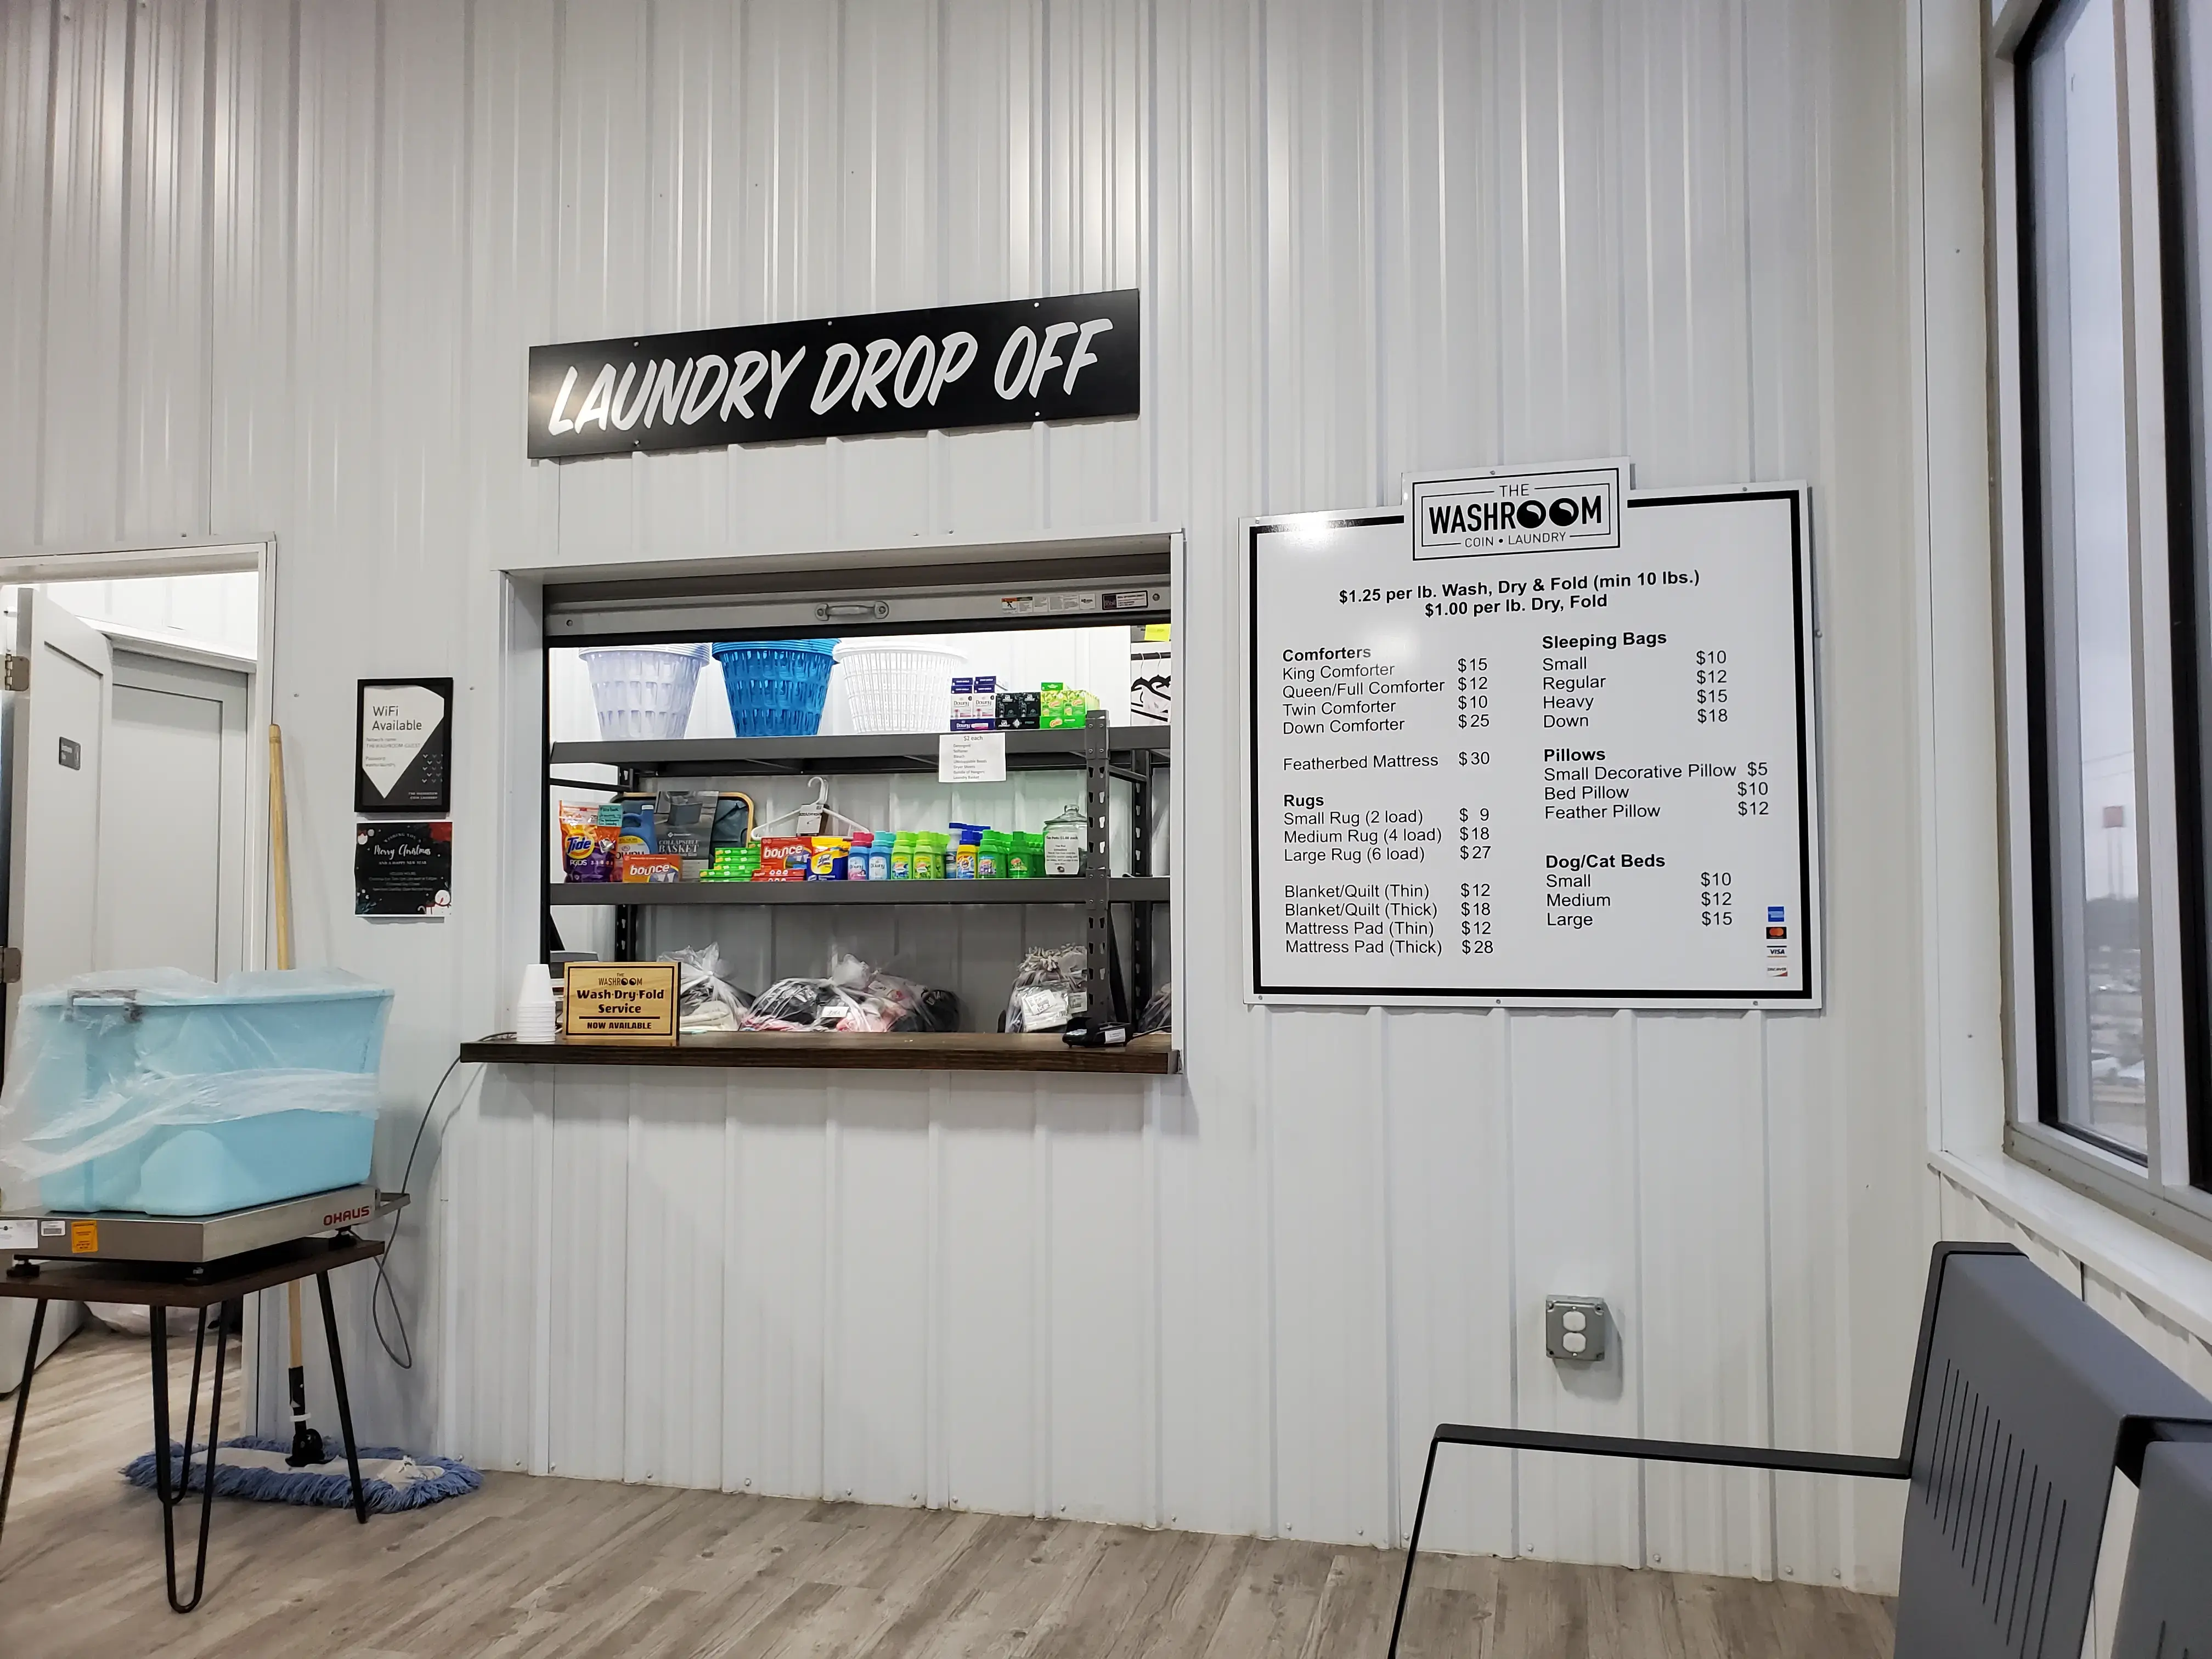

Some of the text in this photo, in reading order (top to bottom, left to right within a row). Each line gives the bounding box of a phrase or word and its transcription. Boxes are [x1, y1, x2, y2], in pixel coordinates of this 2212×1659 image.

[548, 318, 1113, 437] LAUNDRY DROP OFF
[1499, 483, 1530, 498] THE
[1428, 495, 1603, 535] WASHROOM
[1465, 531, 1566, 548] COIN LAUNDRY
[1339, 569, 1700, 605] $1.25 per lb. Wash, Dry & Fold (min 10 lbs.)
[1425, 594, 1607, 618] $1.00 per lb. Dry, Fold
[1542, 632, 1667, 651] Sleeping Bags
[1283, 647, 1371, 662] Comforters
[1543, 650, 1726, 671] Small $10
[1283, 658, 1487, 682] King Comforter $15
[1283, 676, 1488, 699] Queen/Full Comforter $12
[1543, 669, 1727, 693] Regular $12
[1282, 695, 1488, 716] Twin Comforter $10
[1543, 689, 1728, 711] Heavy $15
[373, 706, 399, 716] WiFi
[1544, 708, 1728, 728] Down $18
[372, 720, 422, 730] Available
[1283, 714, 1489, 735] Down Comforter $25
[1284, 751, 1490, 771] Featherbed Mattress $30
[1544, 748, 1606, 762] Pillows
[1544, 761, 1768, 781] Small Decorative Pillow $5
[1545, 781, 1768, 800] Bed Pillow $10
[1284, 794, 1324, 810] Rugs
[1545, 800, 1769, 819] Feather Pillow $12
[1284, 811, 1324, 825] Small
[1330, 811, 1359, 827] Rug
[1365, 810, 1380, 827] (2
[1385, 809, 1423, 826] load)
[1284, 826, 1489, 845] Medium Rug (4 load) $18
[374, 844, 431, 860] Merry Christmas
[567, 837, 591, 854] Tide
[658, 844, 699, 853] BASKET
[763, 844, 804, 859] bounce
[1284, 845, 1491, 865] Large Rug (6 load) $27
[1546, 854, 1666, 872] Dog/Cat Beds
[630, 864, 670, 876] bounce
[1546, 871, 1731, 888] Small $10
[1285, 882, 1491, 901] Blanket/Quilt (Thin) $12
[1547, 891, 1732, 907] Medium $12
[1285, 901, 1491, 919] Blanket/Quilt (Thick) $18
[1285, 920, 1491, 938] Mattress Pad (Thin) $12
[1547, 911, 1733, 929] Large $15
[1286, 939, 1493, 957] Mattress Pad (Thick) $28
[598, 977, 642, 986] WASHROOM
[598, 1002, 641, 1013] Service
[323, 1205, 370, 1226] OHAUS
